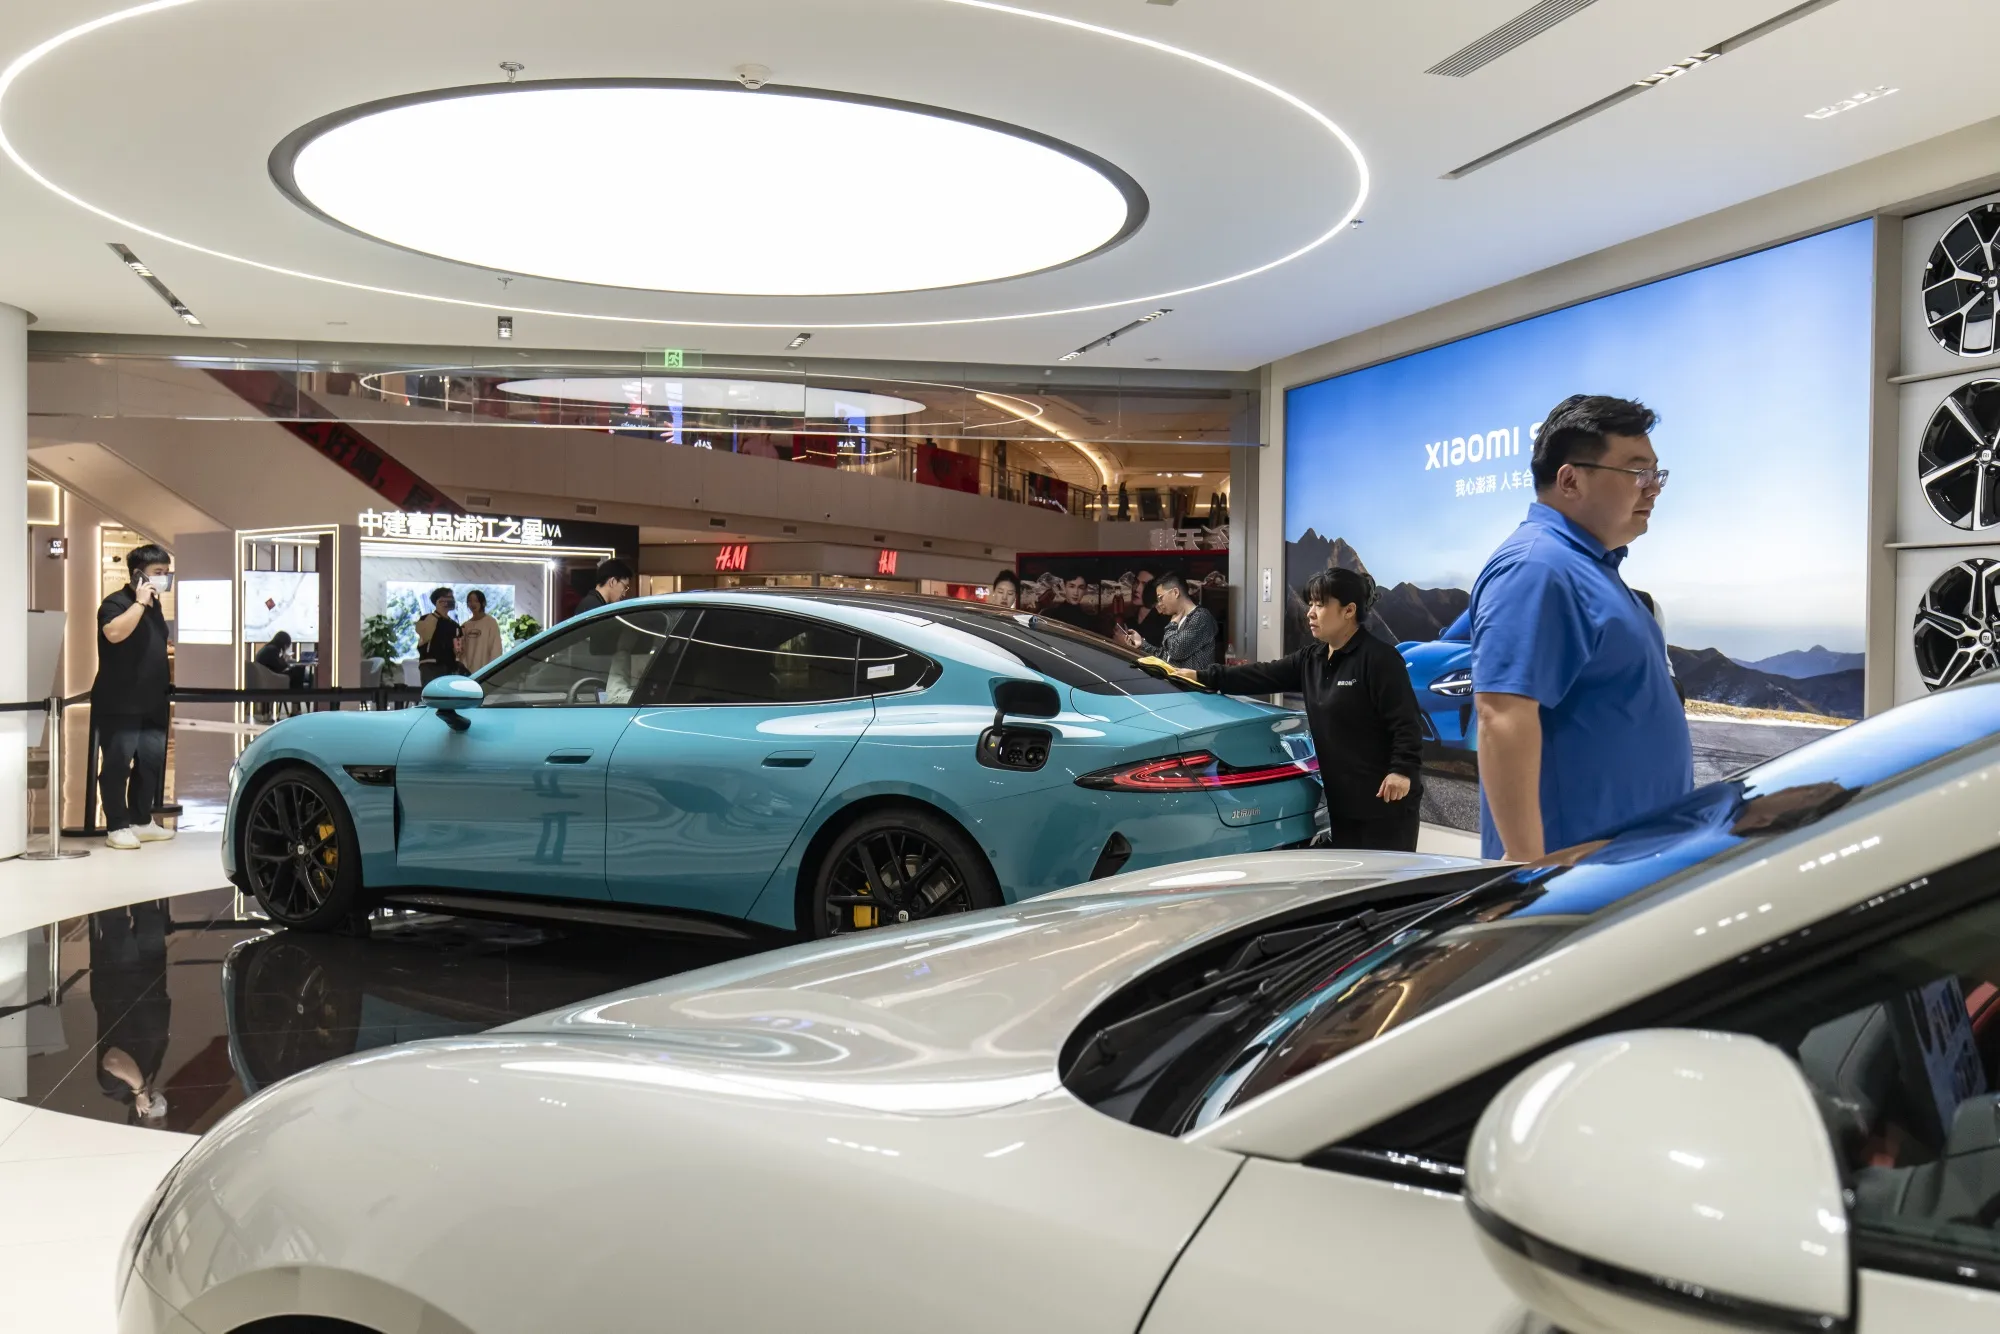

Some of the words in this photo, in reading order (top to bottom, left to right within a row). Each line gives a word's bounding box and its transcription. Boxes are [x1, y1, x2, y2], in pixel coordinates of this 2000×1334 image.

[1455, 474, 1497, 497] 我心澎湃
[358, 508, 543, 546] 中建壹品浦江之星
[715, 545, 748, 571] H&M
[878, 550, 897, 575] H&M
